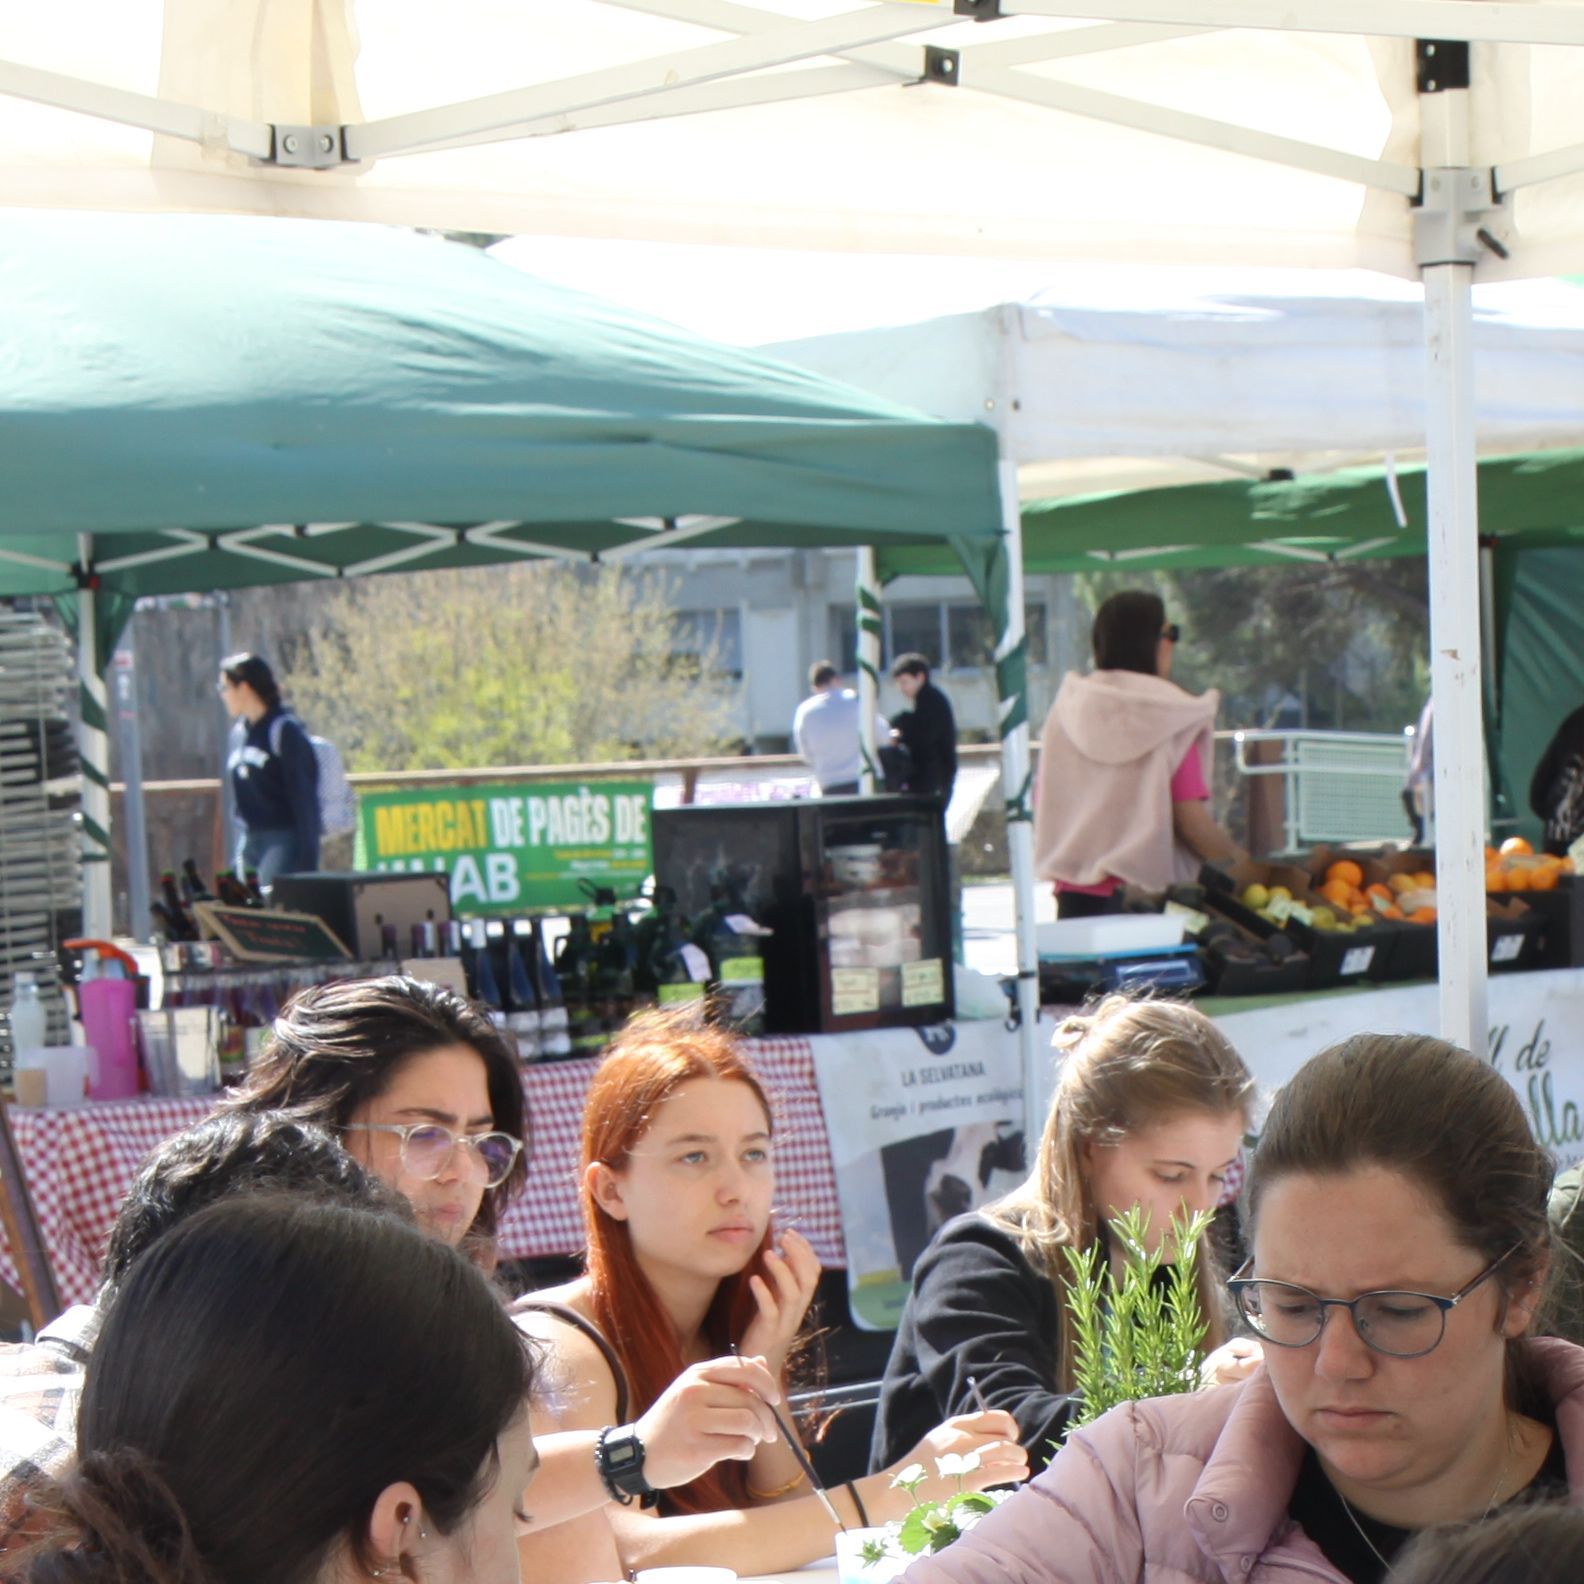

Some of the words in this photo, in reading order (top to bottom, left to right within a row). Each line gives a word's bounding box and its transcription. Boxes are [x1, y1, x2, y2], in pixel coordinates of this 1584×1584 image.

[375, 799, 488, 857] MERCAT
[490, 797, 525, 849] DE
[529, 786, 610, 846] PAGÈS
[613, 794, 647, 844] DE
[1515, 1018, 1551, 1073] de
[900, 1070, 918, 1087] LA
